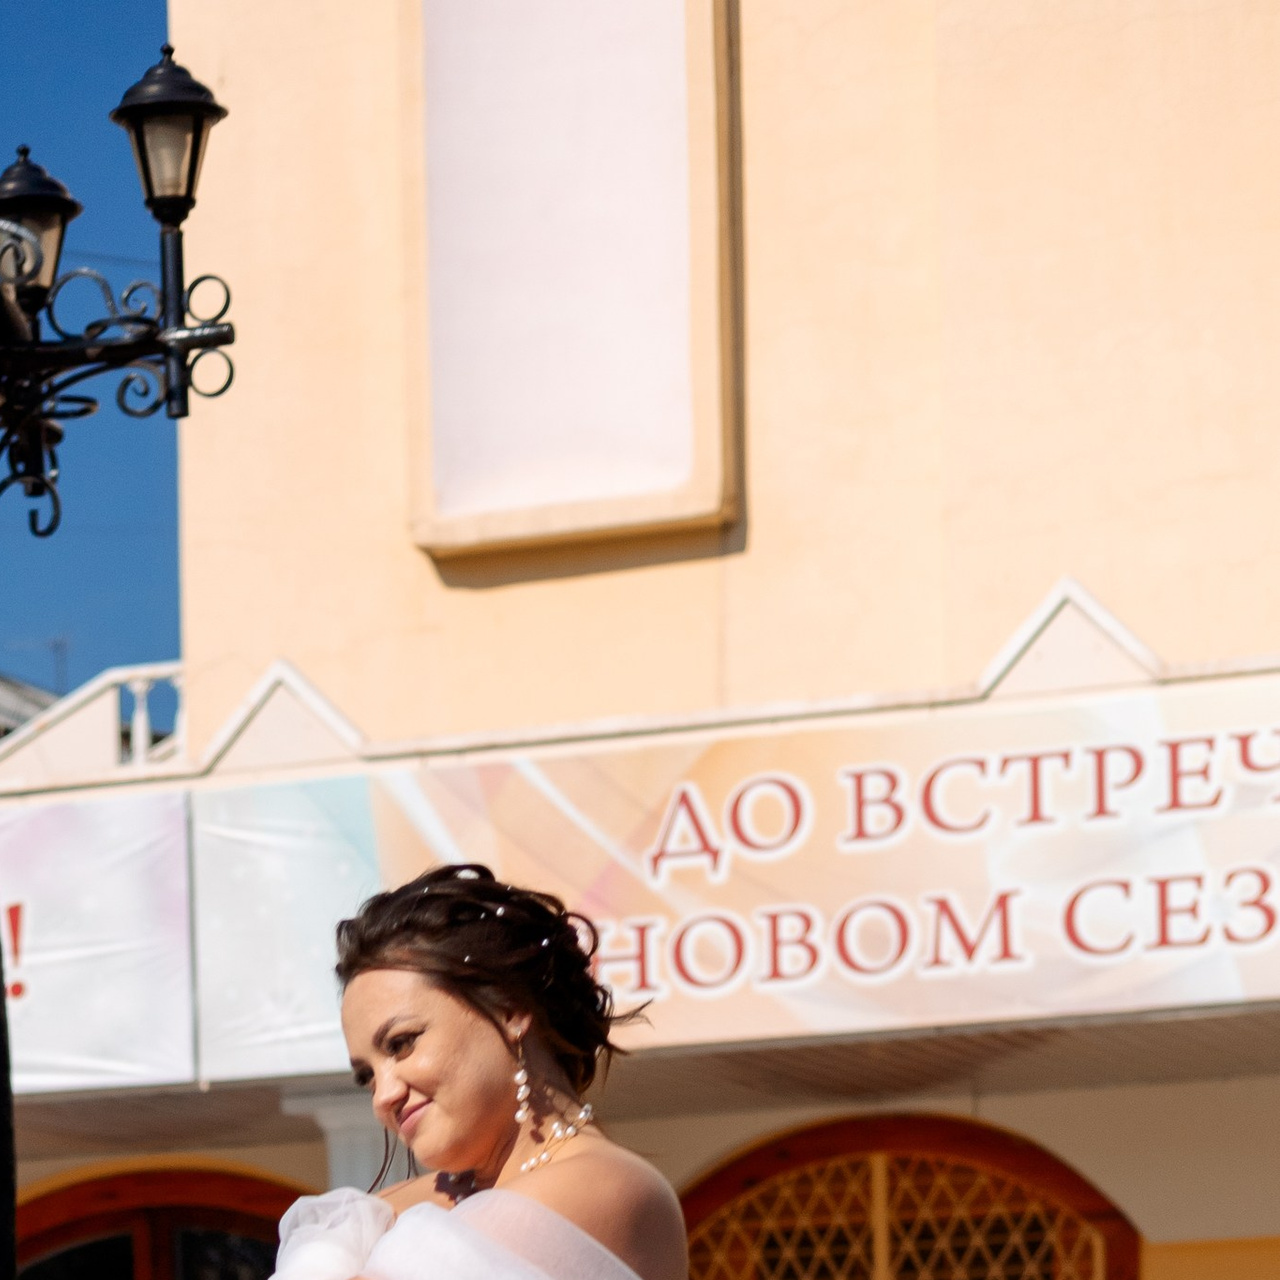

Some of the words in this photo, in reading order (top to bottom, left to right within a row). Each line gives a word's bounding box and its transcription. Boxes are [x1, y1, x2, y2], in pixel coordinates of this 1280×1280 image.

[650, 776, 805, 878] ДО
[590, 890, 1021, 994] НОВОМ
[1064, 866, 1276, 956] СЕЗ
